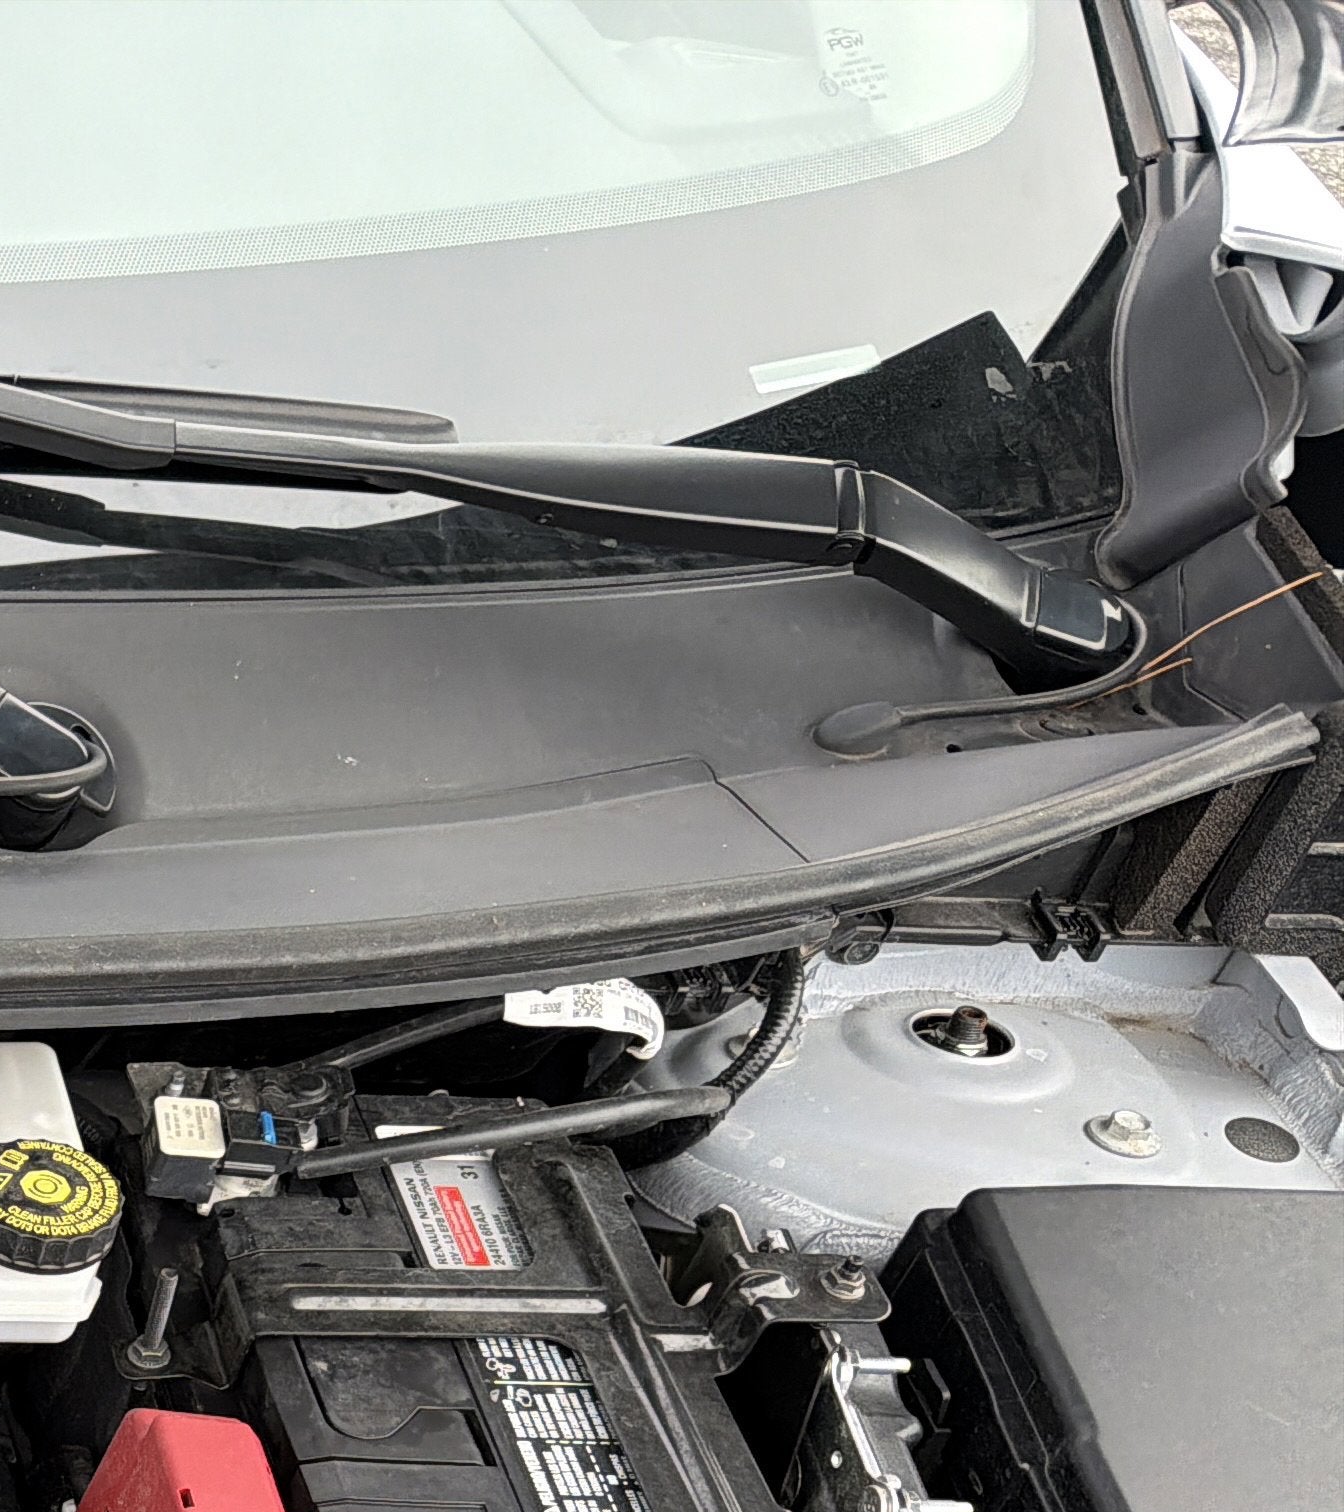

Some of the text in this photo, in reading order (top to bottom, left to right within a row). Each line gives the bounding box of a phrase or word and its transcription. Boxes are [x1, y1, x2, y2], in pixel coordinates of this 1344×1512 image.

[827, 33, 864, 51] PGW
[17, 1141, 73, 1155] CONTAINER
[73, 1151, 106, 1173] SEALED
[456, 1165, 479, 1179] 31
[8, 1152, 103, 1225] CLEAN FILLER CAP BEFORE REMOVING
[6, 1216, 34, 1231] DOT3
[76, 1213, 106, 1233] BRAKE
[403, 1177, 448, 1264] RENAULT NISSAN
[435, 1217, 448, 1232] EFB
[34, 1225, 49, 1235] OR
[51, 1226, 77, 1235] DOT4
[484, 1238, 506, 1265] 24410
